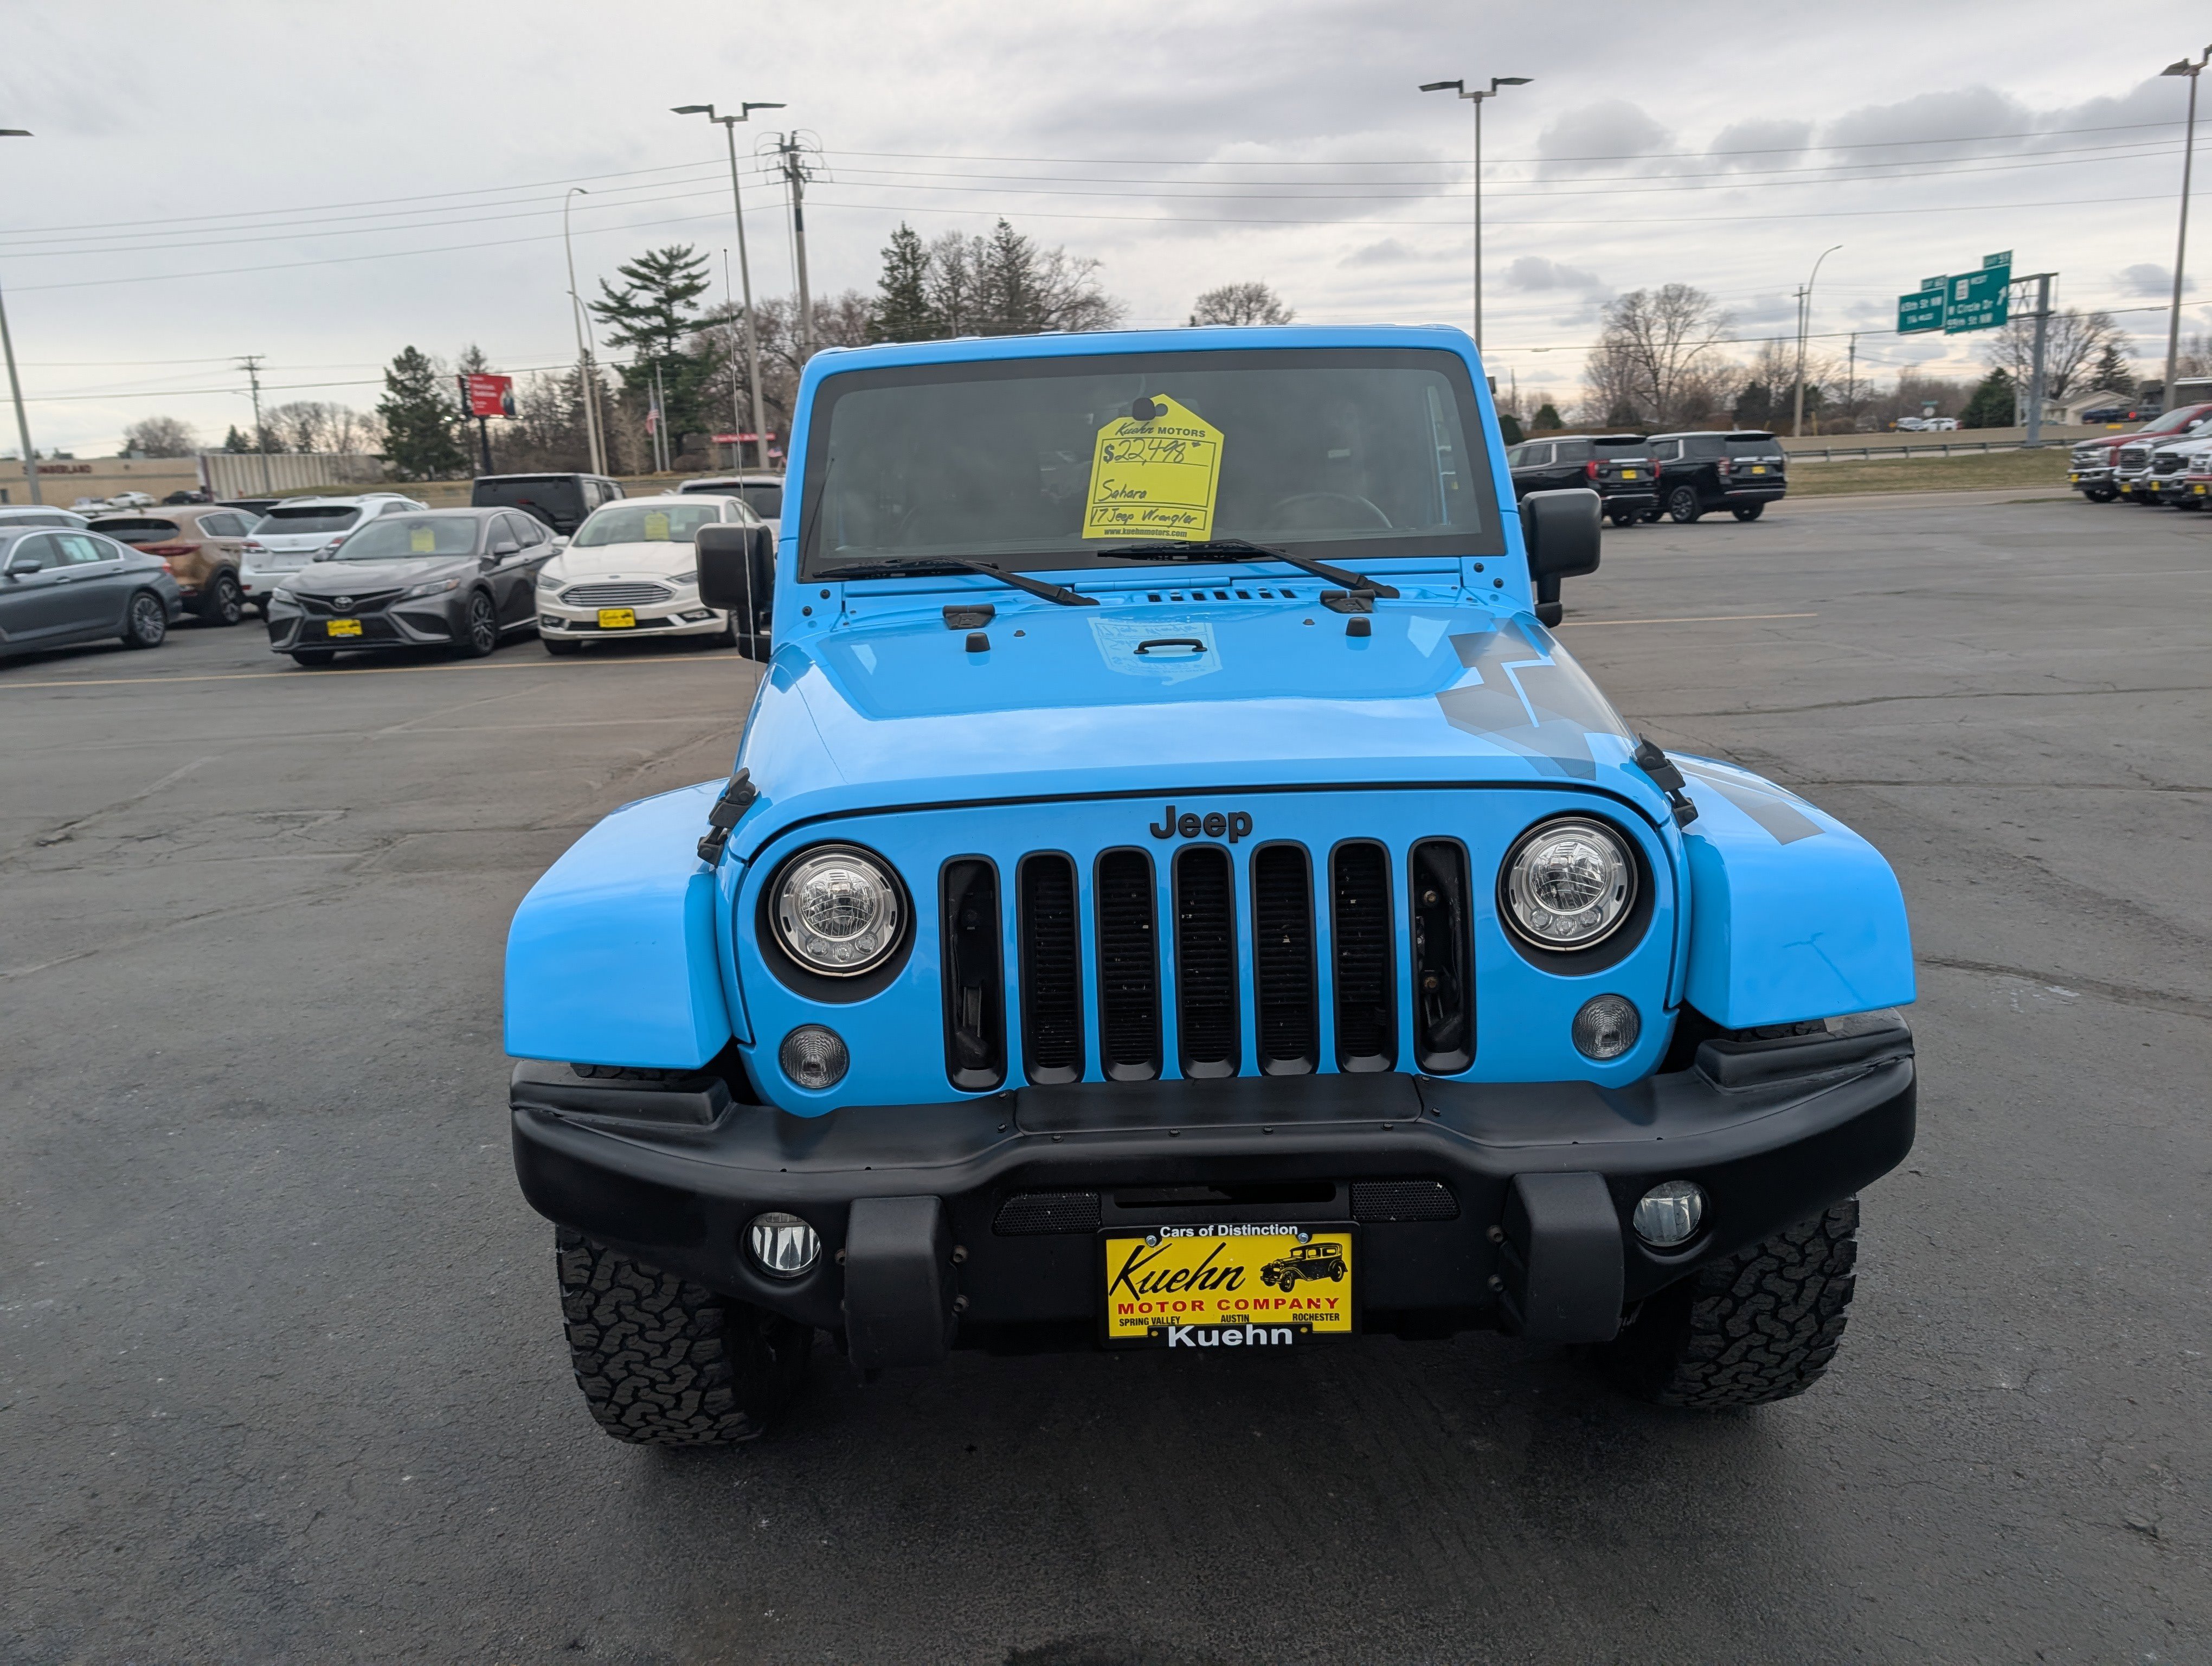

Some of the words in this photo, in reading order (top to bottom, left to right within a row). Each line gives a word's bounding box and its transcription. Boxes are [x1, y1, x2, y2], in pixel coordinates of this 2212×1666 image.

[1115, 422, 1154, 436] Kuehn
[1158, 427, 1206, 438] MOTORS
[1141, 508, 1198, 528] Wrangler
[1104, 528, 1187, 538] www.kuehnmotors.com
[1149, 805, 1253, 844] Jeep
[1160, 1226, 1194, 1238] Cars
[1199, 1225, 1214, 1236] of
[1218, 1223, 1298, 1236] Distinction
[1109, 1241, 1246, 1302] Kuehn
[1117, 1300, 1205, 1315] MOTOR
[1217, 1297, 1340, 1311] COMPANY
[1119, 1317, 1149, 1327] SPRING
[1152, 1316, 1181, 1325] VALLEY
[1220, 1314, 1250, 1323] AUSTIN
[1292, 1313, 1340, 1322] ROCHESTER
[1168, 1324, 1293, 1347] Kuehn
